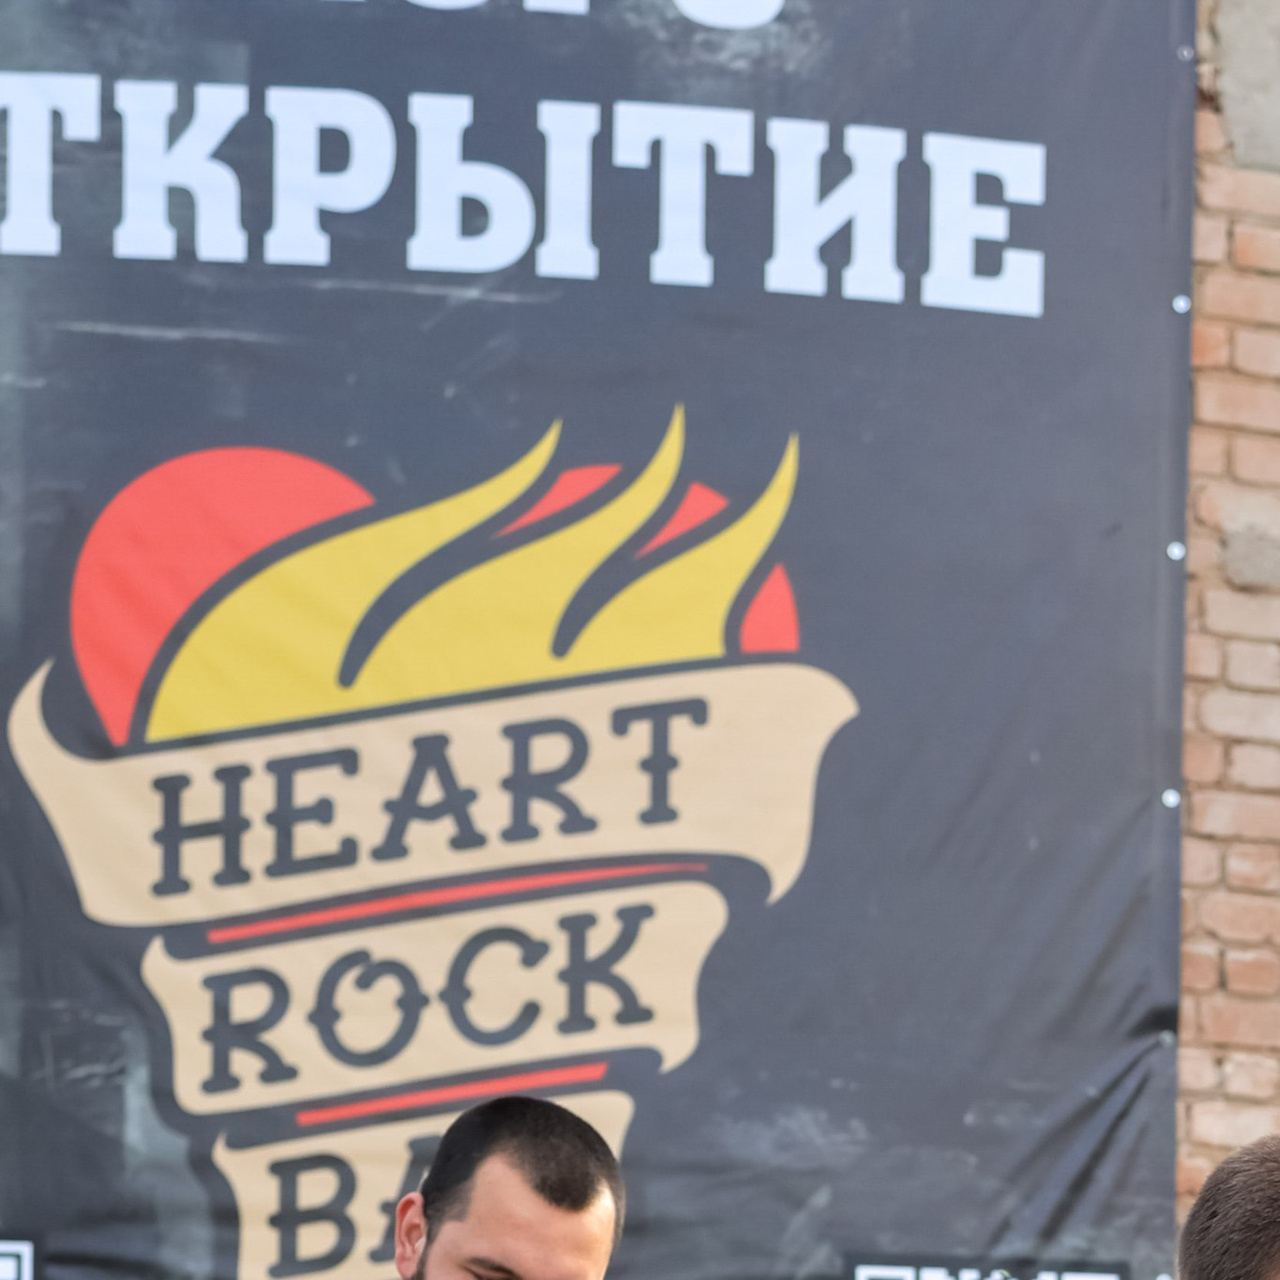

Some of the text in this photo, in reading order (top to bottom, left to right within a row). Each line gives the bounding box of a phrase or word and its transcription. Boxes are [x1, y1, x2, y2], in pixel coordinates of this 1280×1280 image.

[0, 72, 1045, 317] ТКРЫТИЕ
[152, 698, 707, 897] HEART
[202, 904, 655, 1094] ROCK
